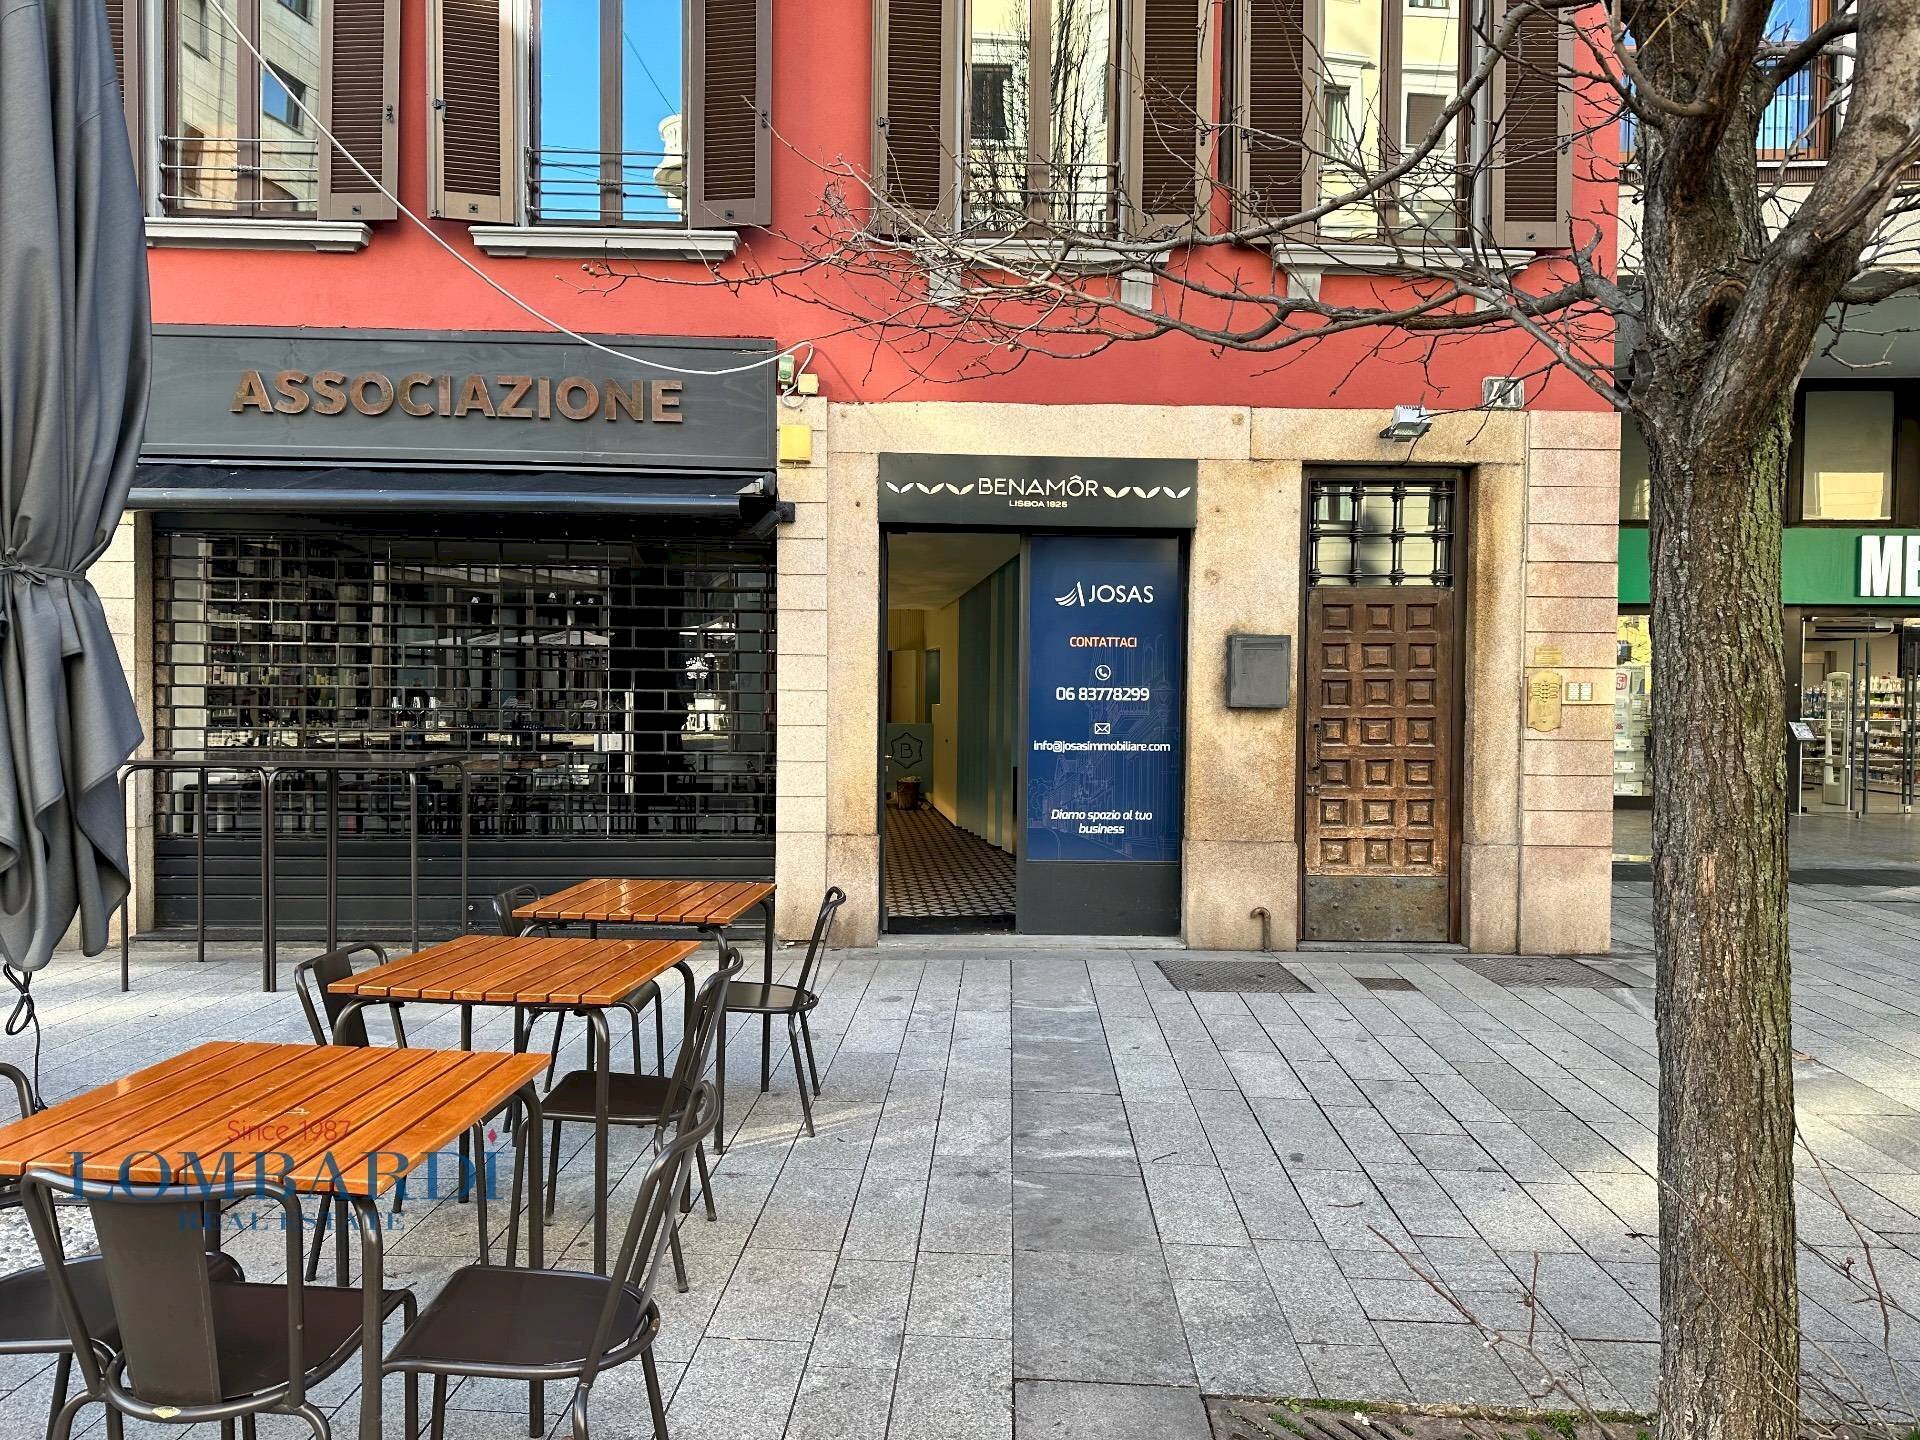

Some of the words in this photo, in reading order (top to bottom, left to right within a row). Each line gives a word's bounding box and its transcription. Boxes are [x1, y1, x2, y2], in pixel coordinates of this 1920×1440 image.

[229, 369, 684, 423] ASSOCIAZIONE
[1487, 381, 1517, 407] 41
[978, 475, 1099, 497] BENAMÔR
[1008, 500, 1045, 508] LISBOA
[1088, 584, 1154, 603] JOSAS
[1069, 636, 1137, 648] CONTATTACI
[1055, 687, 1076, 701] 06
[1078, 687, 1150, 701] 83778299
[1033, 740, 1171, 753] info@josasimmobiliare.com
[1050, 809, 1086, 820] Diamo
[1087, 810, 1121, 823] spazio
[1122, 809, 1133, 820] al
[1134, 810, 1153, 820] tuo
[1078, 823, 1125, 834] business
